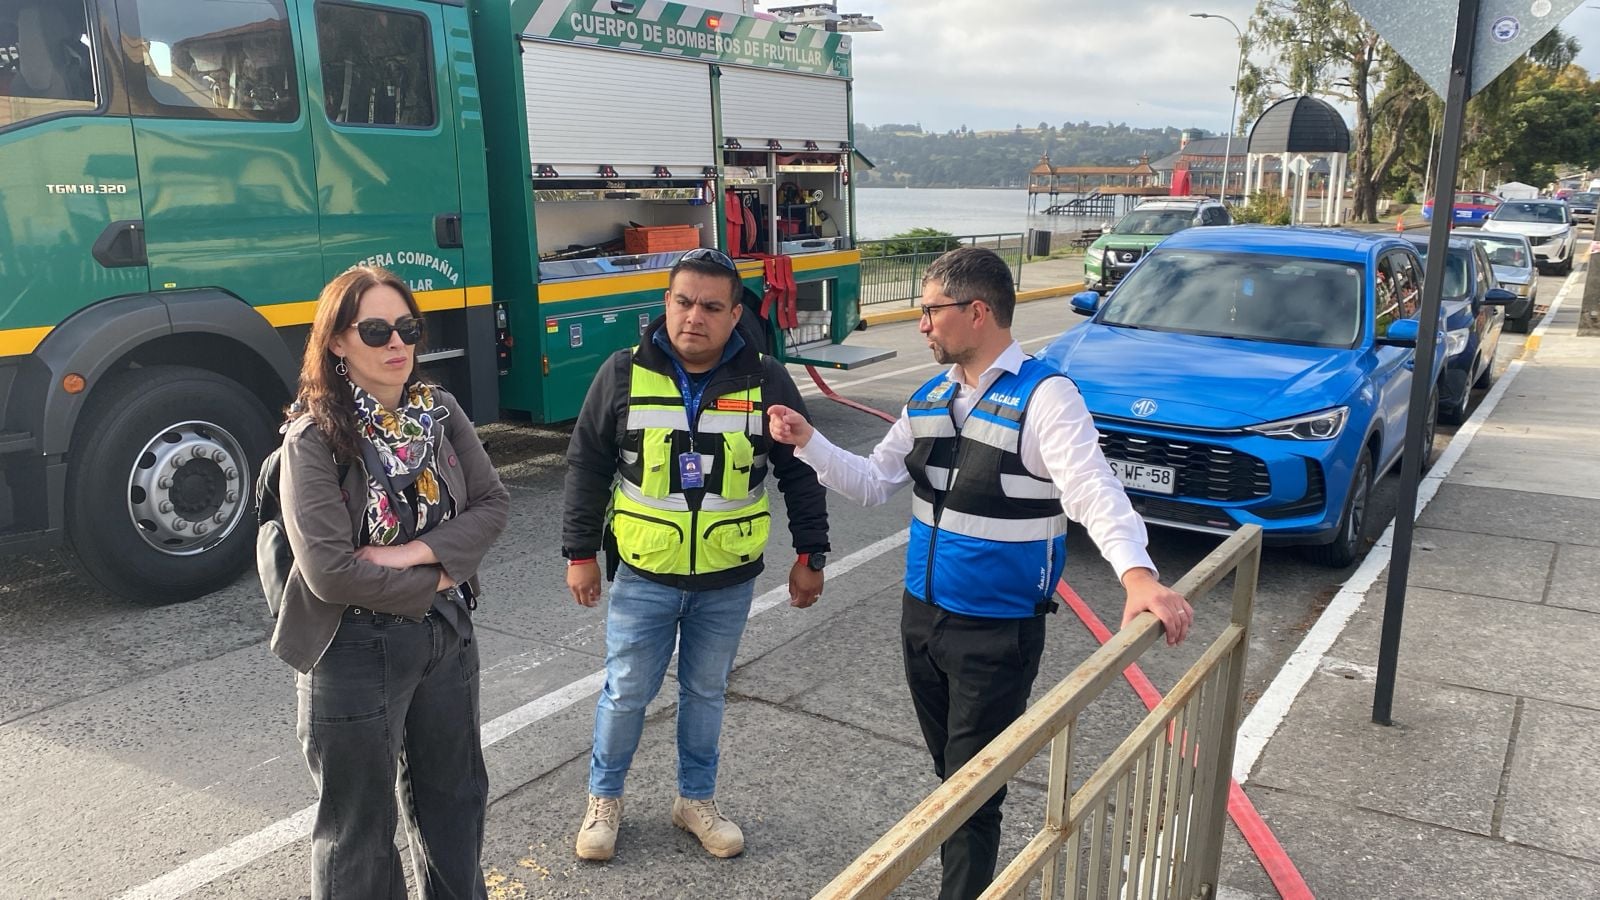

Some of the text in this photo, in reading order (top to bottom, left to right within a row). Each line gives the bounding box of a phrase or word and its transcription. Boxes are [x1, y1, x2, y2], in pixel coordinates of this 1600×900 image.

[570, 12, 638, 40] CUERPO
[642, 23, 662, 43] DE
[666, 26, 741, 54] BOMBEROS
[744, 40, 760, 57] DE
[763, 43, 822, 66] FRUTILLAR
[46, 184, 127, 194] TGM 18.320
[397, 251, 459, 286] COMPAÑIA
[1132, 399, 1157, 417] MG
